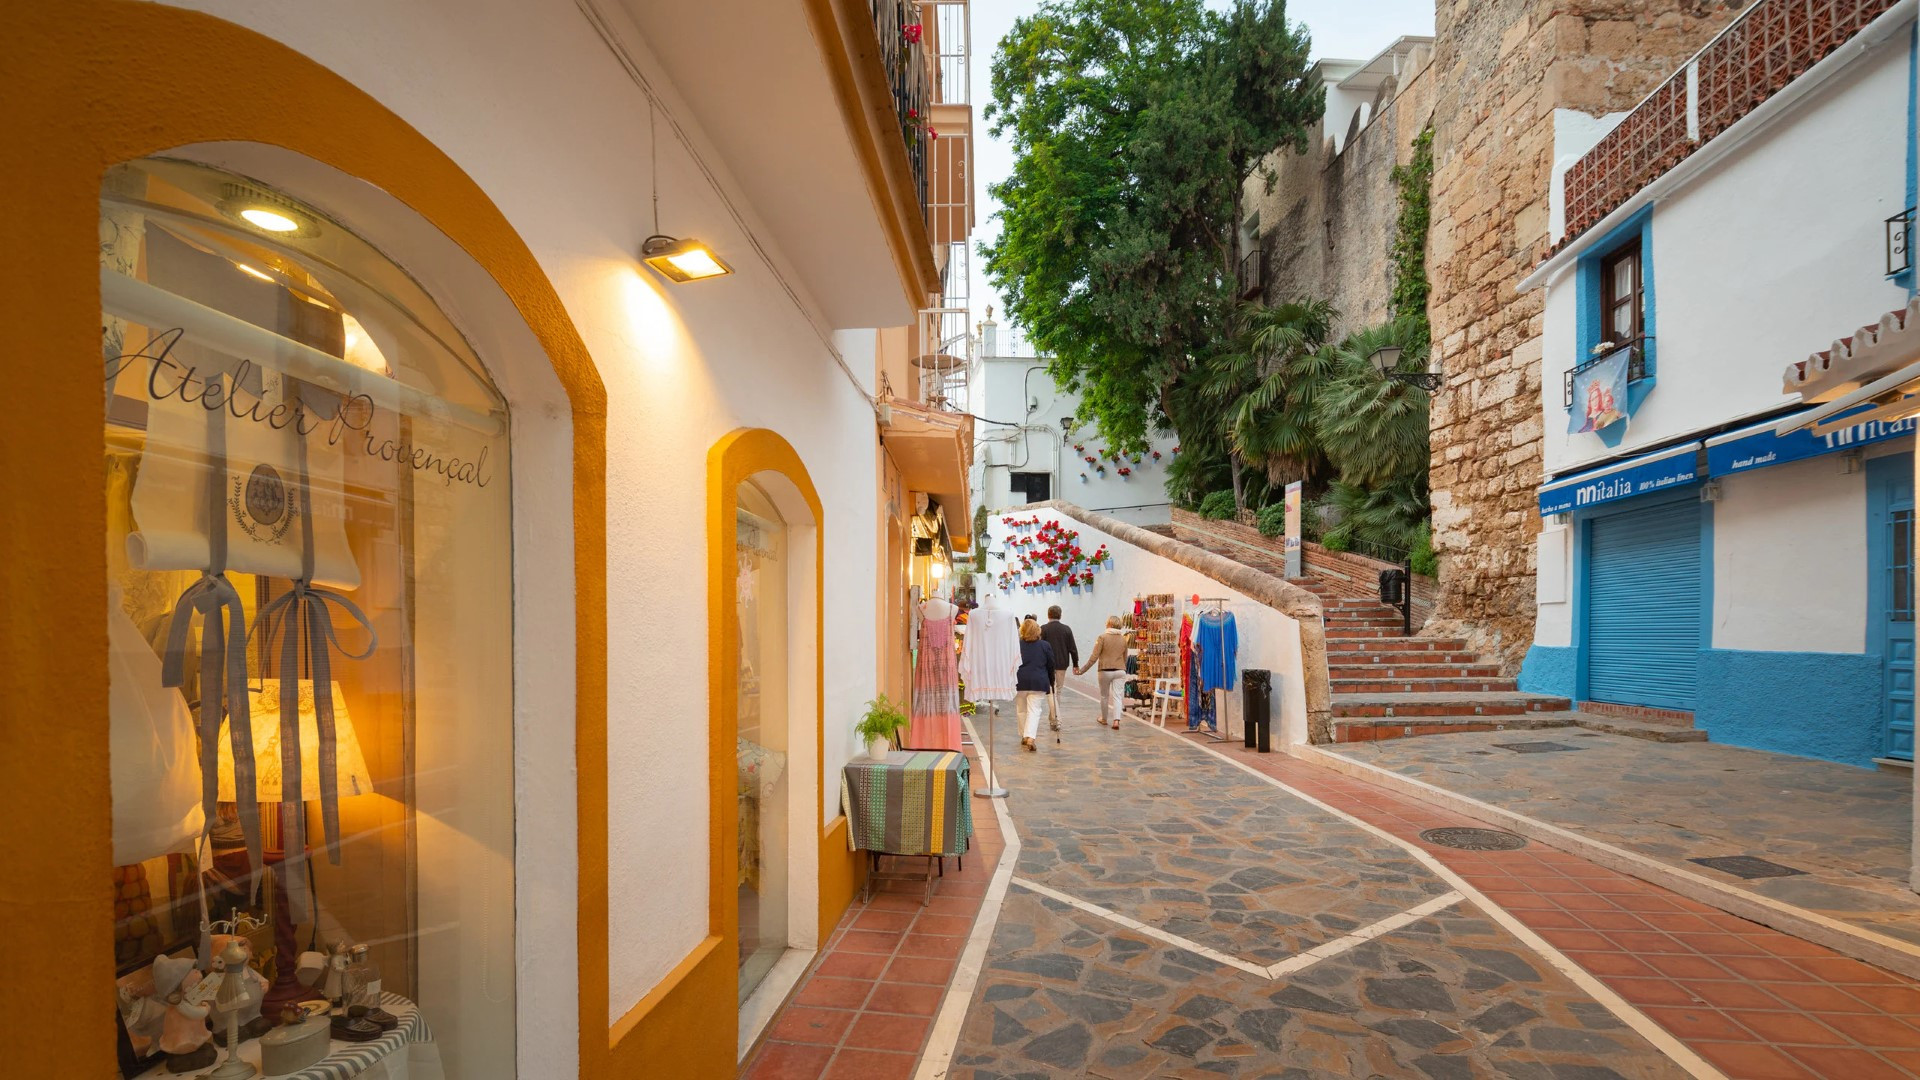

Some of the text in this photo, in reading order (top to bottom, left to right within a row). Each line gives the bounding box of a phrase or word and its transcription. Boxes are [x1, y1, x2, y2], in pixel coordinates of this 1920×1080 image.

[102, 327, 492, 488] Atelier Provençal
[1731, 451, 1777, 469] hand made
